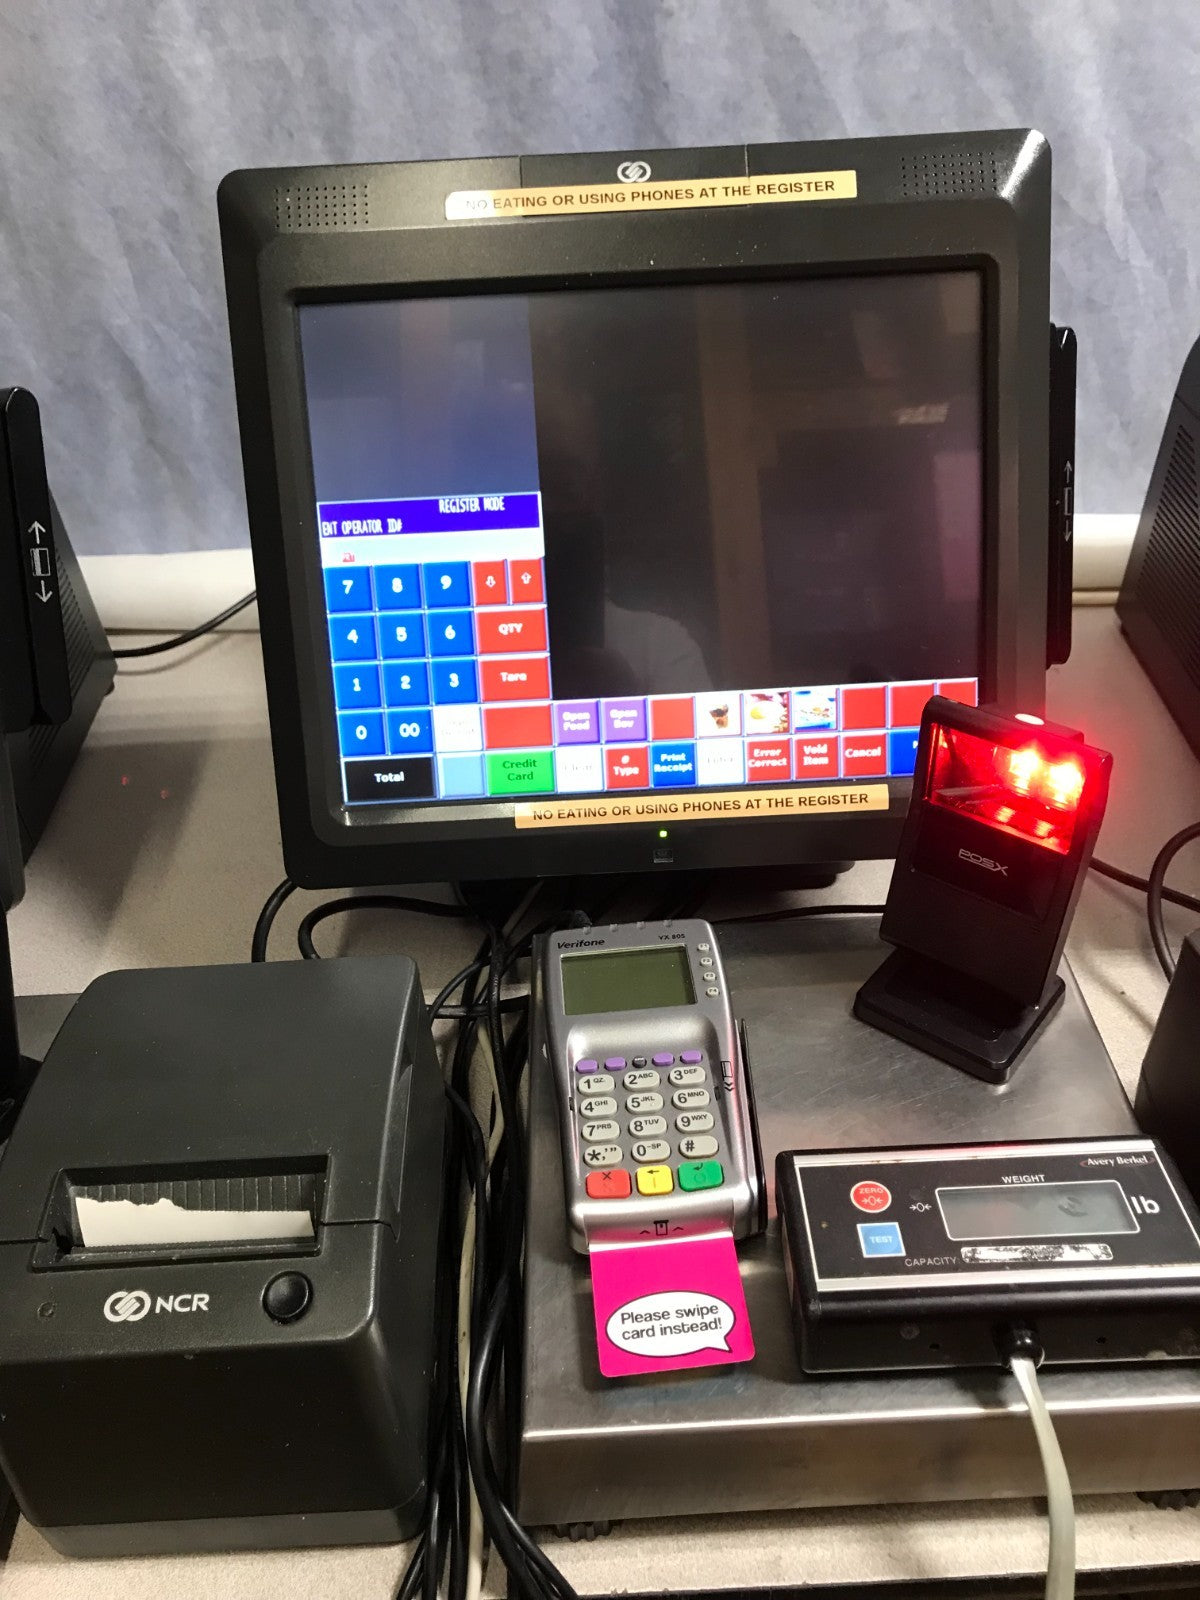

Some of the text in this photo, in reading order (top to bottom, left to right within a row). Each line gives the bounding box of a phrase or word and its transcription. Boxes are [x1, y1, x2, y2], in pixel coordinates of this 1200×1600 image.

[492, 195, 548, 210] EATING
[552, 193, 575, 207] OR
[579, 190, 627, 206] USING
[630, 187, 695, 203] PHONES
[699, 186, 720, 199] AT
[722, 183, 752, 198] THE
[755, 179, 836, 196] REGISTER
[438, 496, 506, 514] REGISTER MODE
[321, 520, 338, 537] ENT
[341, 519, 383, 535] OPERATOR
[342, 579, 354, 595] 7
[391, 577, 404, 593] 8
[440, 574, 452, 590] 9
[347, 628, 359, 644] 4
[395, 626, 408, 642] 5
[444, 623, 456, 640] 6
[352, 677, 362, 692] 1
[399, 675, 411, 690] 2
[449, 672, 460, 688] 3
[499, 671, 528, 683] Tare
[355, 724, 368, 740] 0
[660, 752, 687, 763] Print
[844, 746, 882, 759] Cancel
[502, 758, 538, 770] Credit
[653, 761, 694, 773] Receipt
[373, 771, 405, 784] Total
[507, 771, 534, 782] Card
[532, 791, 869, 821] NO EATING OR USING PHONES AT THE REGISTER
[556, 938, 606, 950] Verifone
[1086, 1153, 1149, 1168] Avery Berkel
[1001, 1173, 1046, 1184] WEIGHT
[858, 1186, 884, 1195] ZERO
[1130, 1196, 1161, 1215] lb
[869, 1234, 894, 1245] TEST
[904, 1255, 958, 1268] CAPACITY
[155, 1293, 210, 1314] NCR
[620, 1303, 719, 1325] Please swipe
[621, 1316, 723, 1341] card instead!
